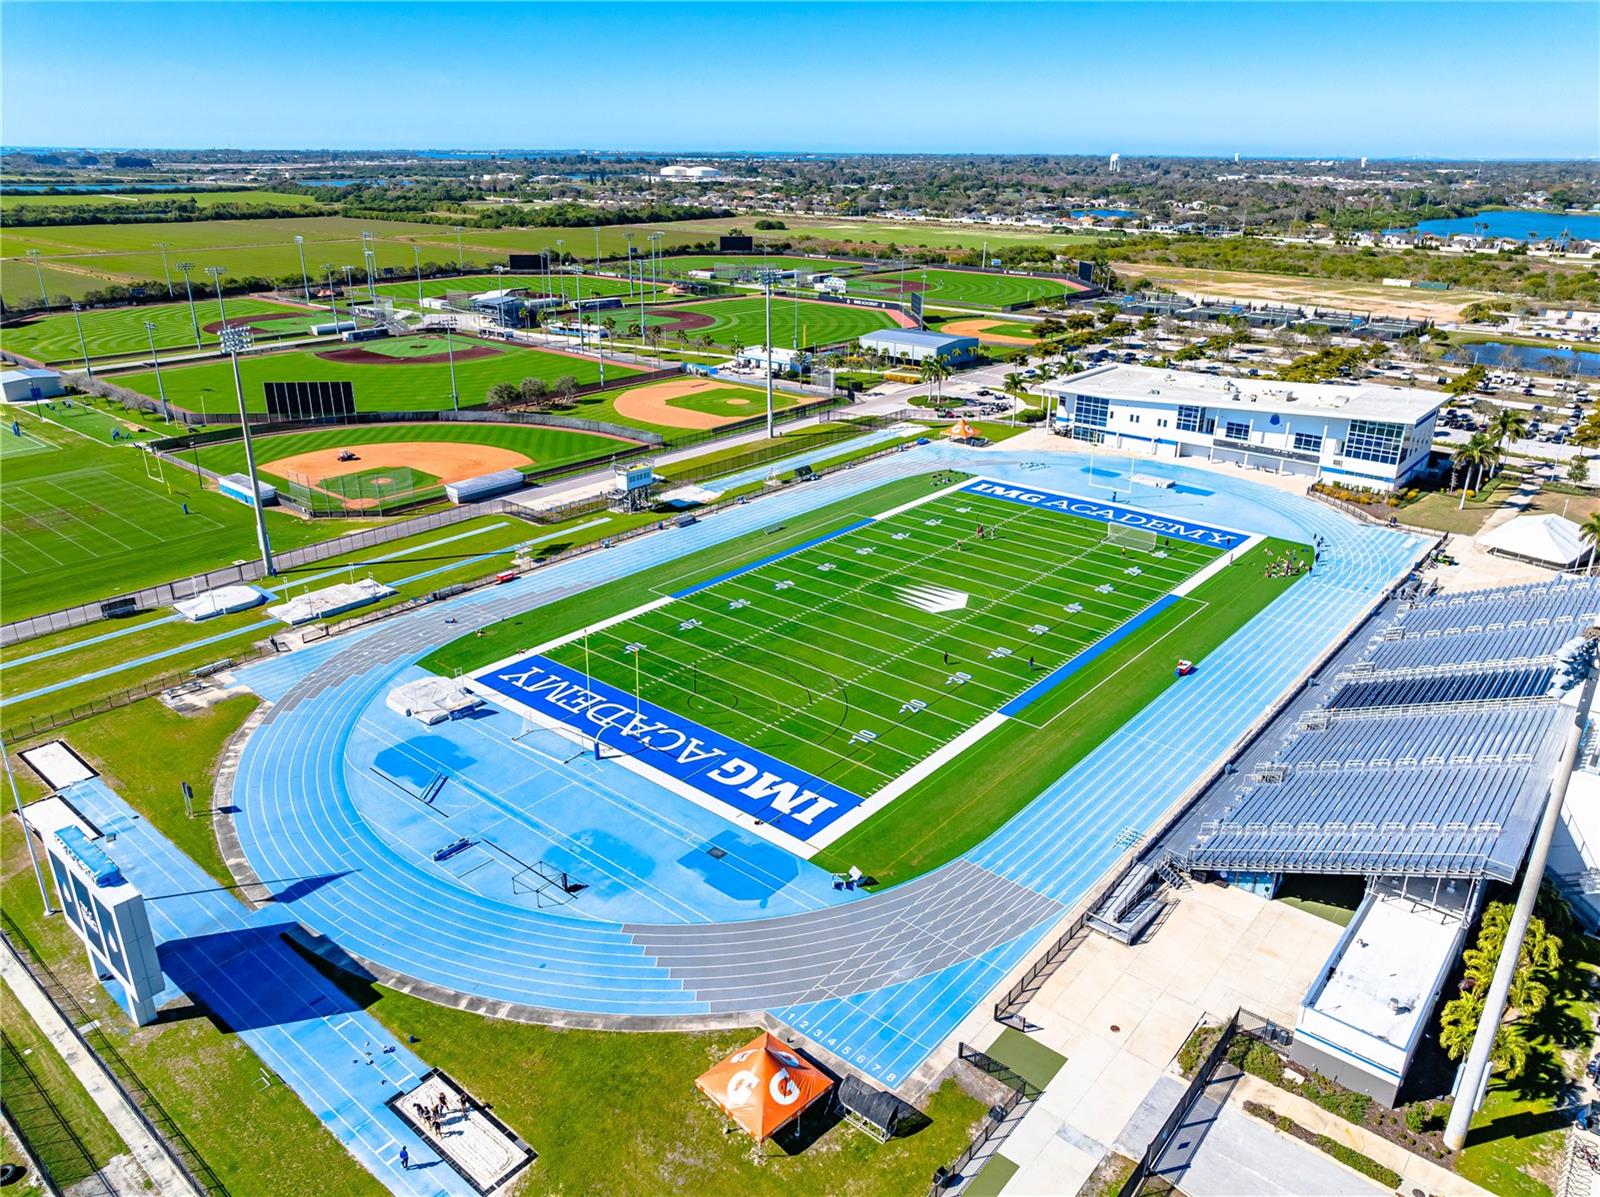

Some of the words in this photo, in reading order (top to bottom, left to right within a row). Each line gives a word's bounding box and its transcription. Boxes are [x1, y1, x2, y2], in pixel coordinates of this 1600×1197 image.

[970, 482, 1049, 503] IMG
[1048, 499, 1238, 545] ACADEMY
[949, 671, 972, 684] 30
[498, 666, 727, 765] ACADEMY
[902, 699, 928, 713] 20
[853, 729, 877, 743] 10
[705, 758, 839, 825] IMG
[799, 1021, 809, 1029] 2
[813, 1029, 823, 1037] 3
[827, 1038, 837, 1046] 4
[841, 1046, 852, 1055] 5
[856, 1055, 866, 1064] 6
[871, 1063, 882, 1072] 7
[886, 1073, 897, 1082] 8
[727, 1070, 761, 1105] G
[769, 1067, 800, 1105] G
